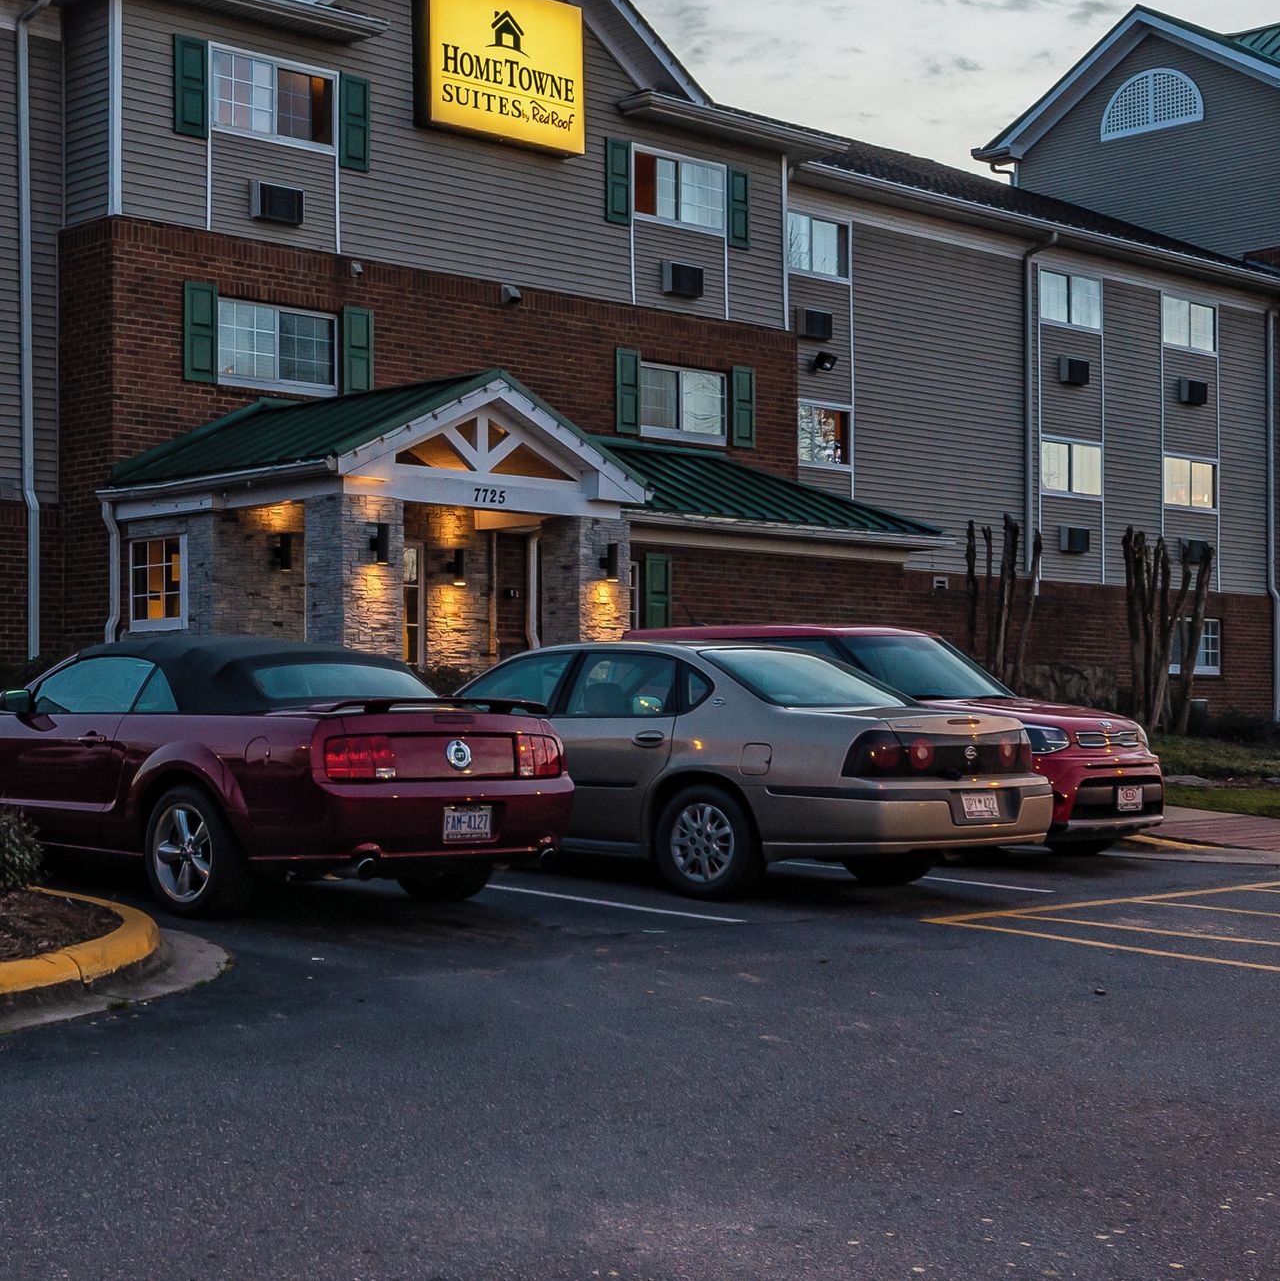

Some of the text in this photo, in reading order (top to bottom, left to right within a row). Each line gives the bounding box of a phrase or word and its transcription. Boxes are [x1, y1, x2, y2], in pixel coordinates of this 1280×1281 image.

[442, 83, 521, 118] SUITES
[521, 109, 530, 123] by
[474, 487, 506, 504] 7725
[445, 814, 489, 831] FAM-4127
